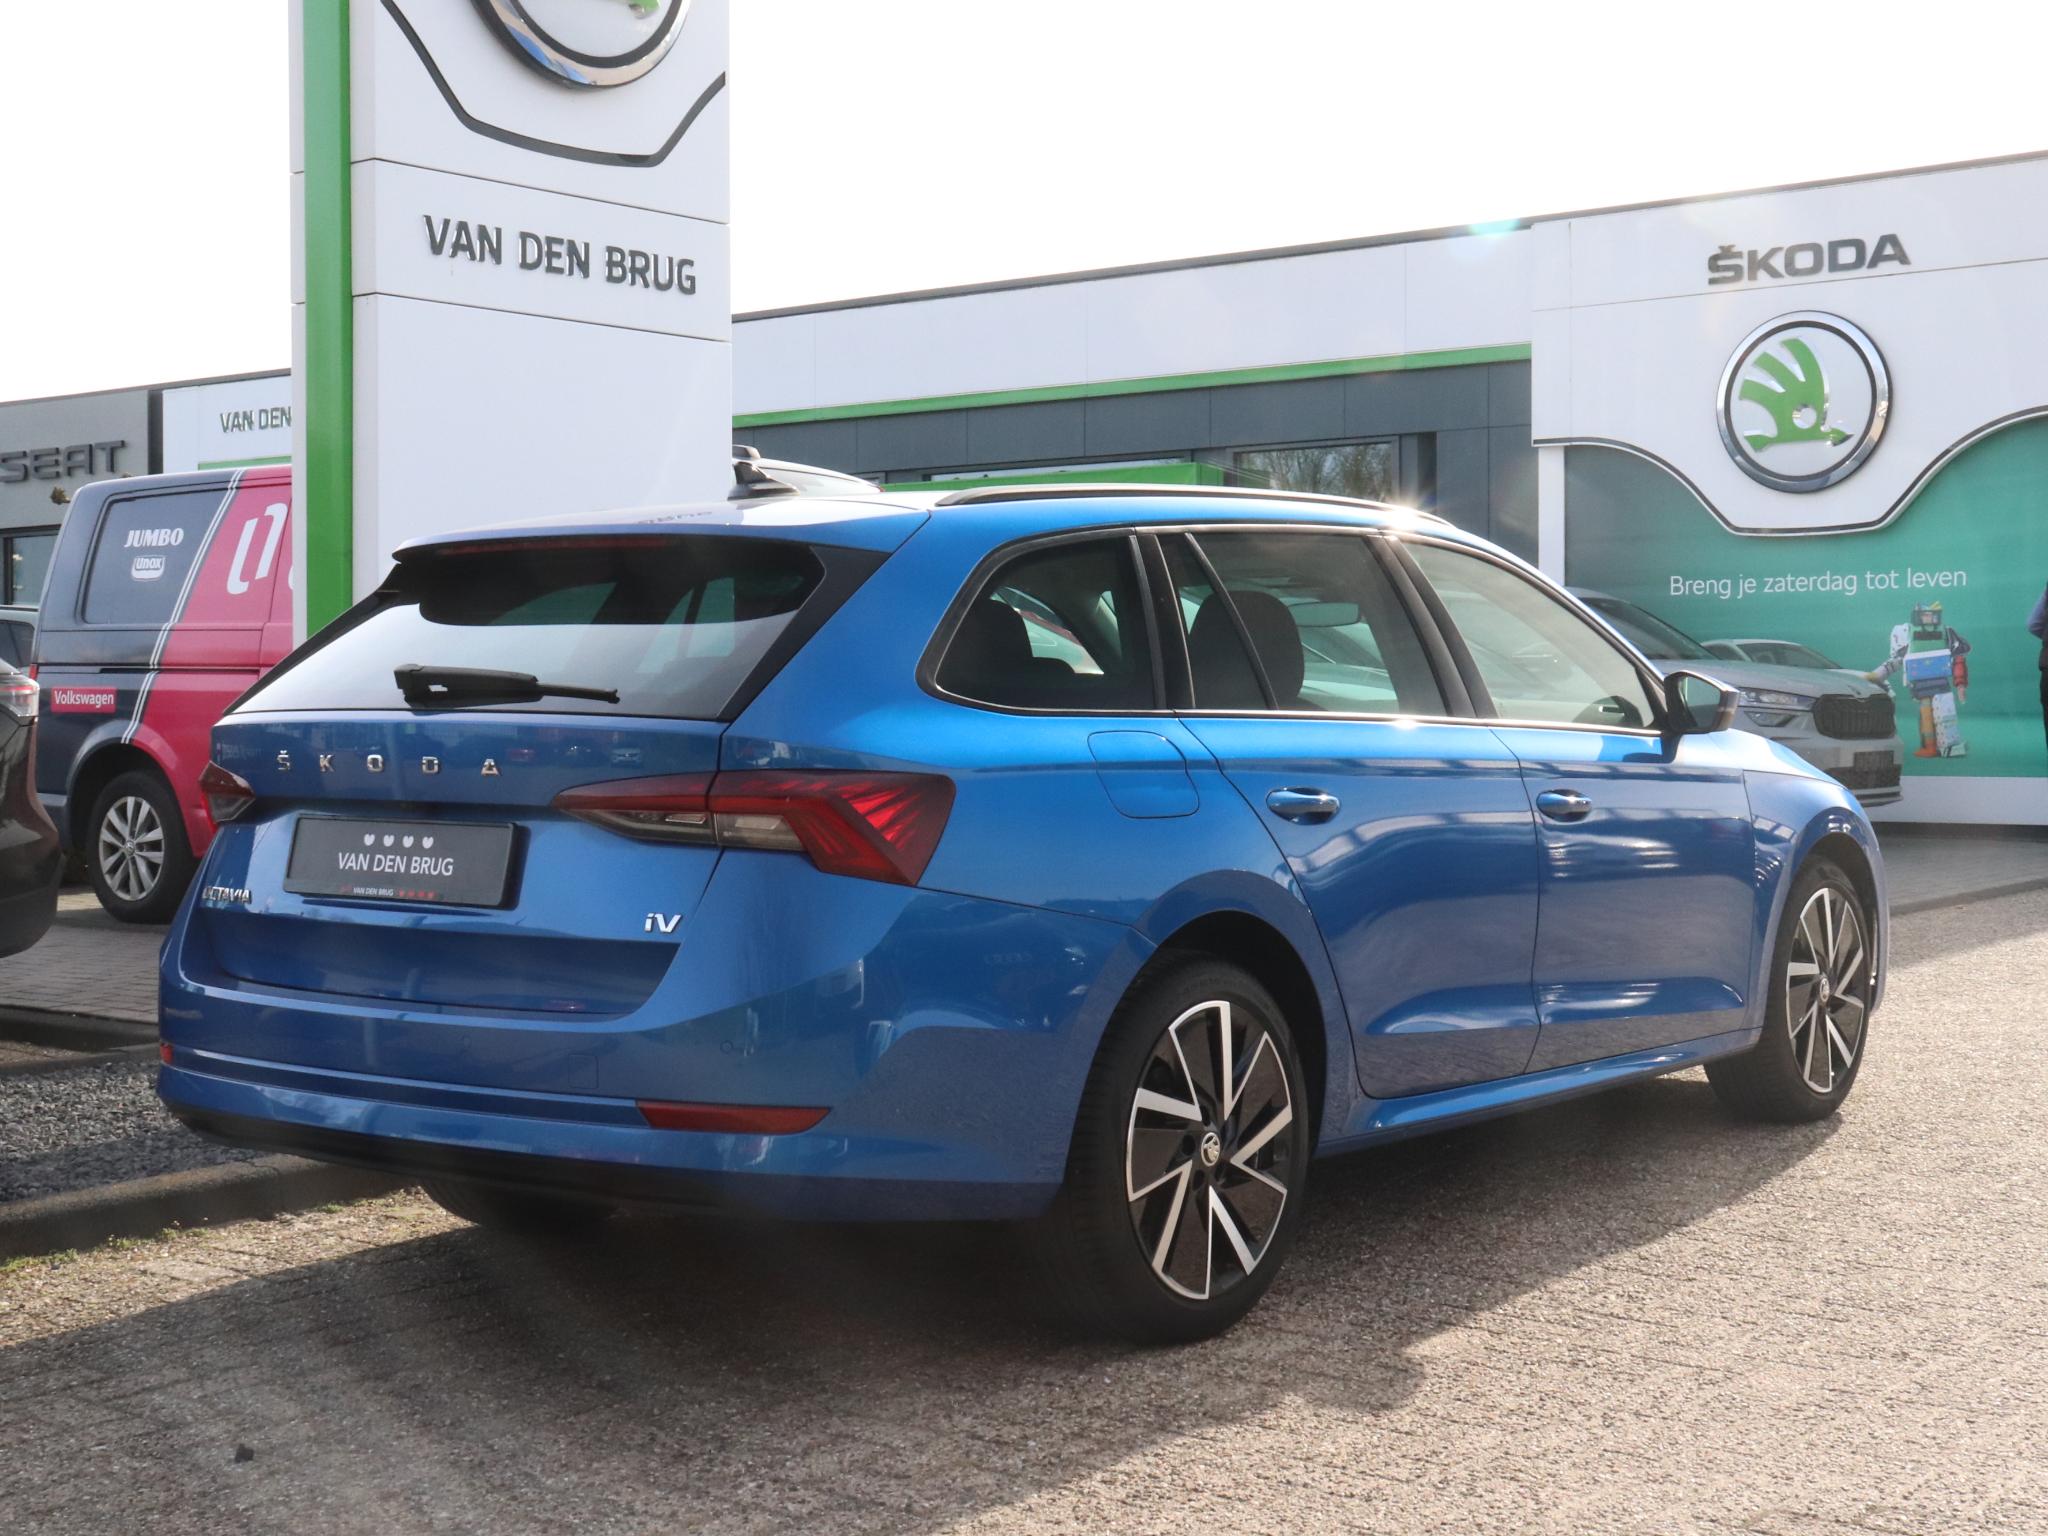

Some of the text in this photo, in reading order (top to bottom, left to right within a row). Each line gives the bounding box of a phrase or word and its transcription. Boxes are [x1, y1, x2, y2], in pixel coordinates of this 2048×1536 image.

[423, 214, 696, 295] VAN DEN BRUG
[1707, 233, 1911, 285] ŠKODA
[220, 406, 292, 433] VAN DEN
[0, 440, 126, 484] SEAT
[124, 528, 184, 548] JUMBO
[1669, 567, 1967, 599] Breng je zaterdag tot leven
[54, 690, 114, 708] Volkswagen
[338, 852, 454, 876] VAN DEN BRUG
[644, 912, 682, 933] iV
